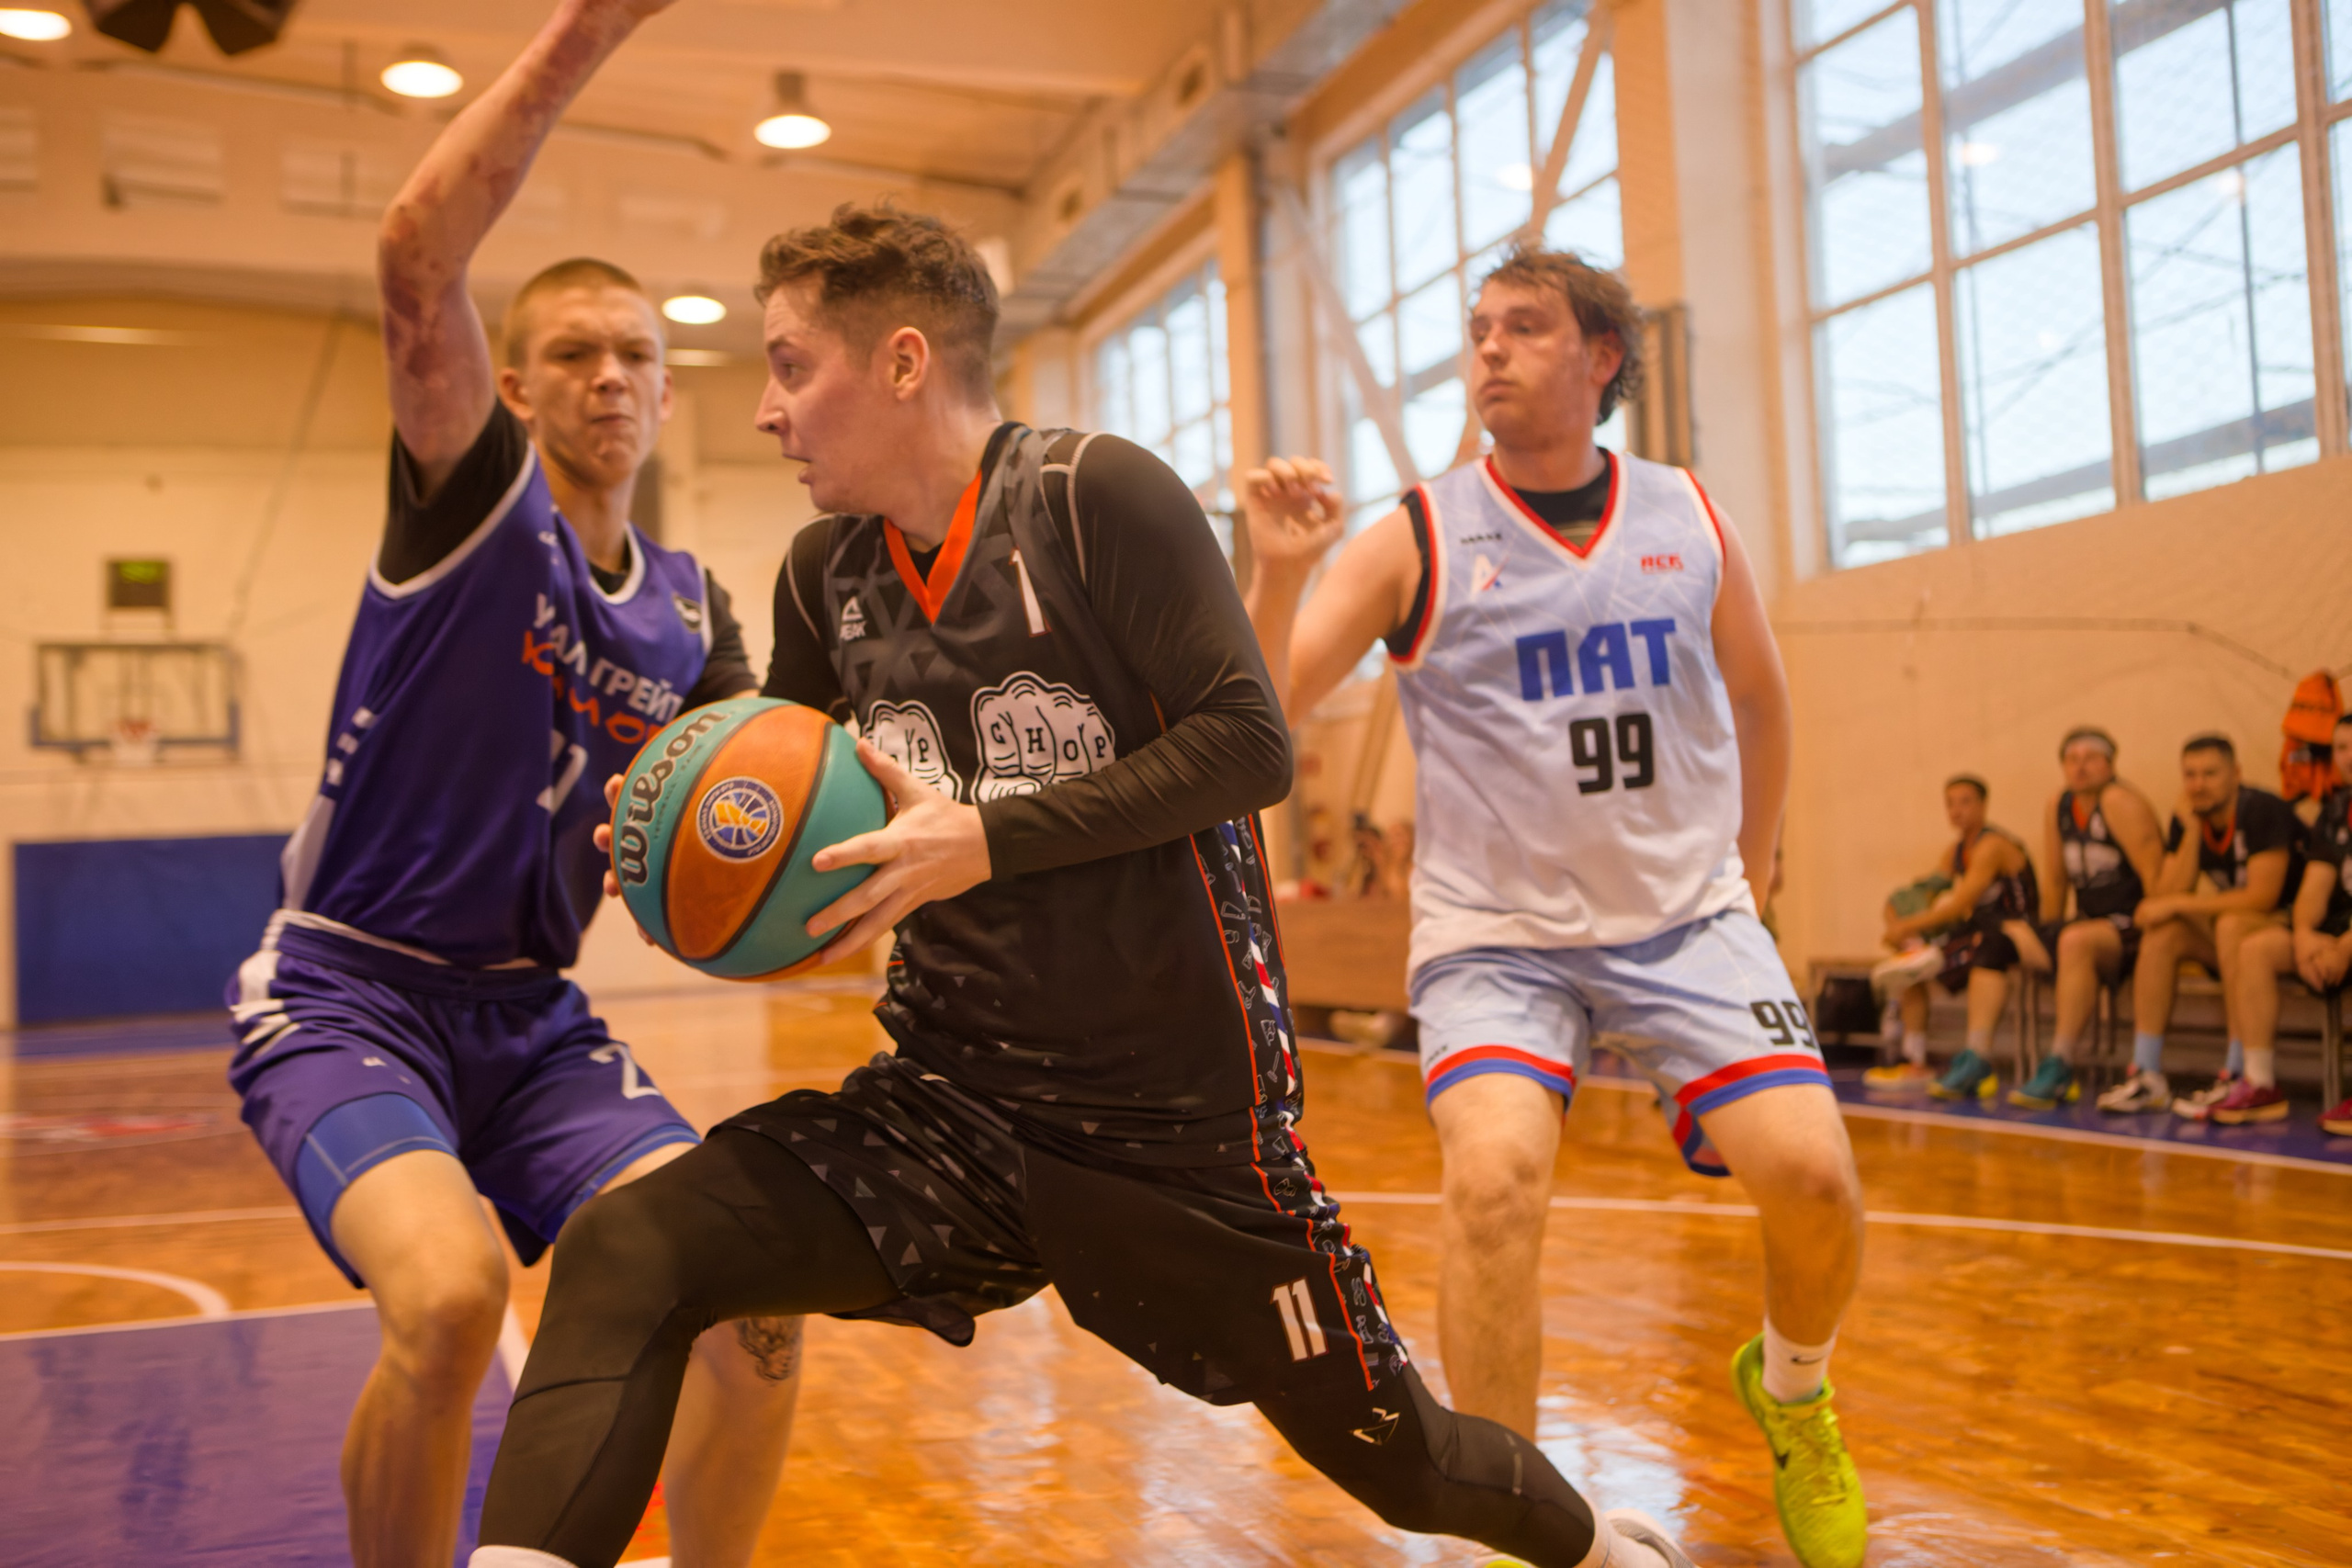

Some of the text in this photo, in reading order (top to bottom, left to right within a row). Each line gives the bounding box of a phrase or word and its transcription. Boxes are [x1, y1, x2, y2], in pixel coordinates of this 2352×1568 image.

[1516, 618, 1677, 701] ПАТ
[1569, 711, 1655, 796] 99
[621, 711, 732, 888] Wilson
[1750, 1000, 1816, 1049] 99
[1270, 1276, 1329, 1362] 11
